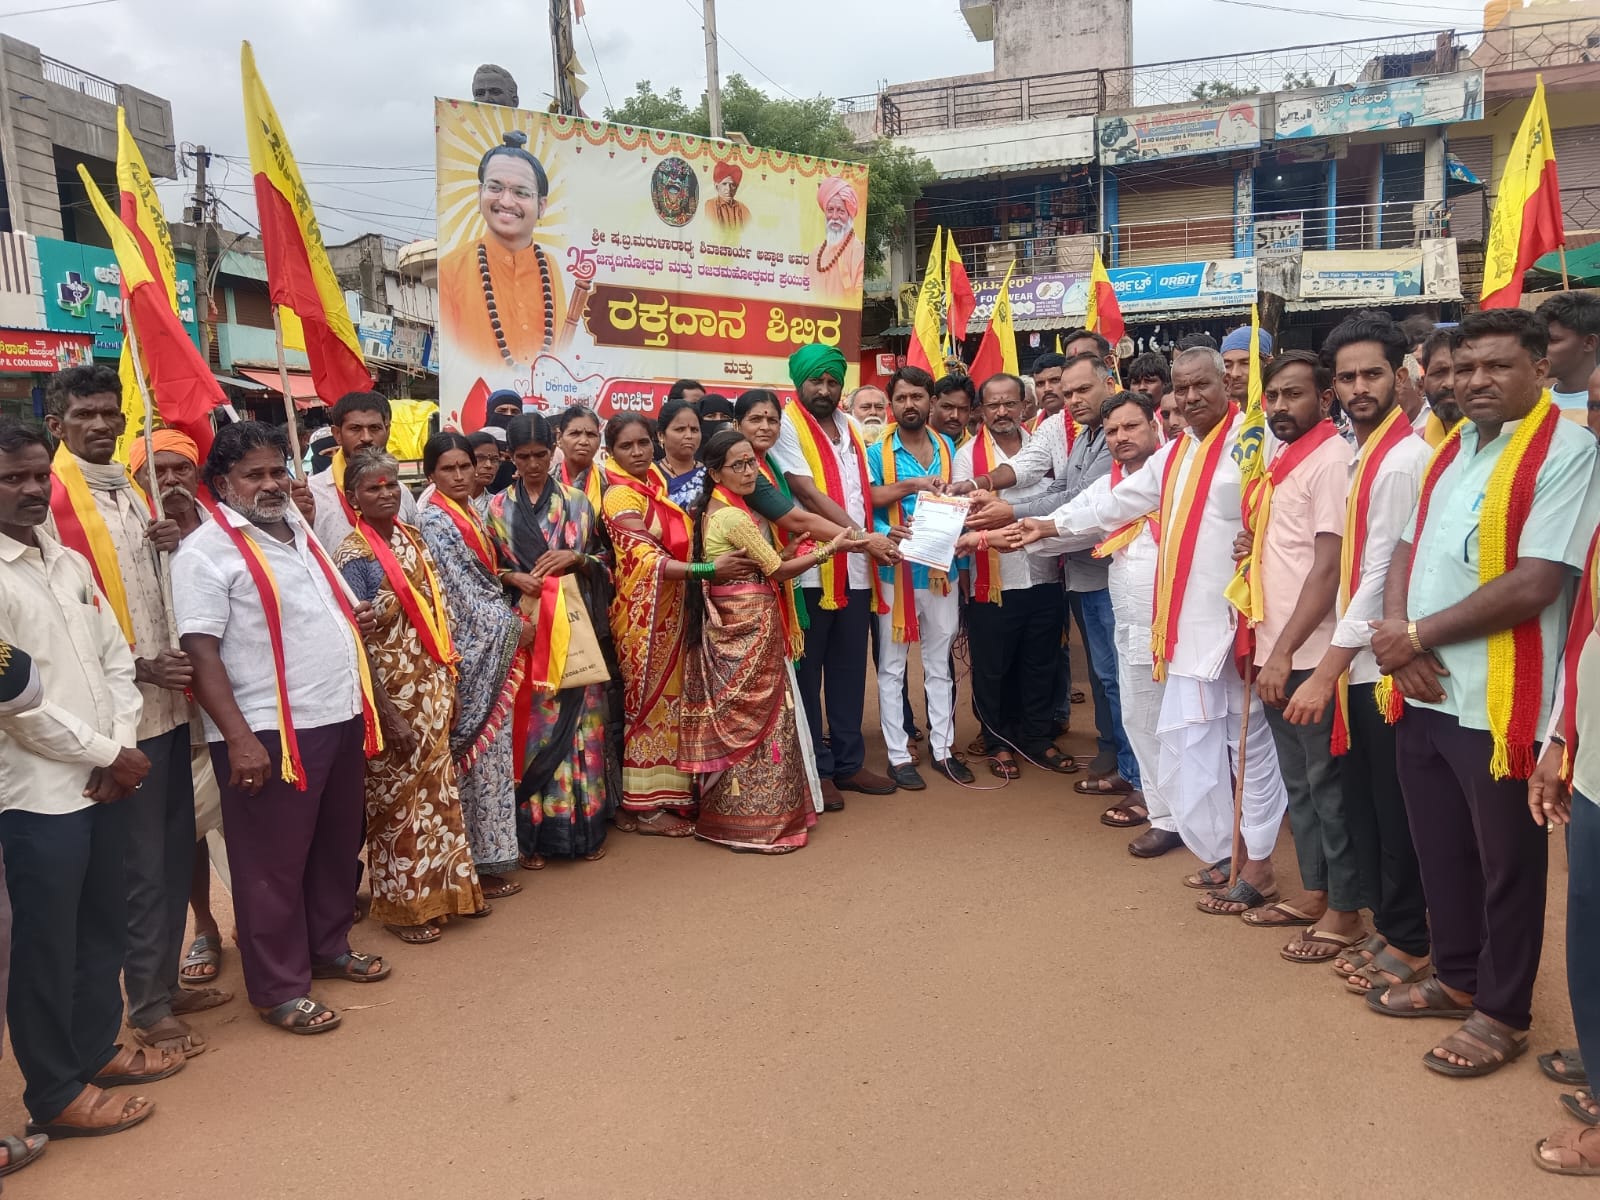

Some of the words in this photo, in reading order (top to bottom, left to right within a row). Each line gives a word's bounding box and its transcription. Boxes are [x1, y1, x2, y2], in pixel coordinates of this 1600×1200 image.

[591, 228, 606, 246] ಶ್ರೀ
[788, 254, 809, 266] ಅವರ
[668, 262, 693, 279] ಮತ್ತು
[1160, 274, 1198, 285] ORBIT
[980, 292, 1033, 303] FOOWEAR
[608, 292, 746, 347] ರಕ್ತದಾನ
[766, 307, 841, 346] ಶಿಬಿರ
[13, 358, 53, 367] COOLDRINKS
[724, 360, 753, 380] ಮತ್ತು
[545, 381, 578, 393] Donate
[564, 395, 590, 407] Blood
[611, 388, 654, 412] ಉಚಿತ
